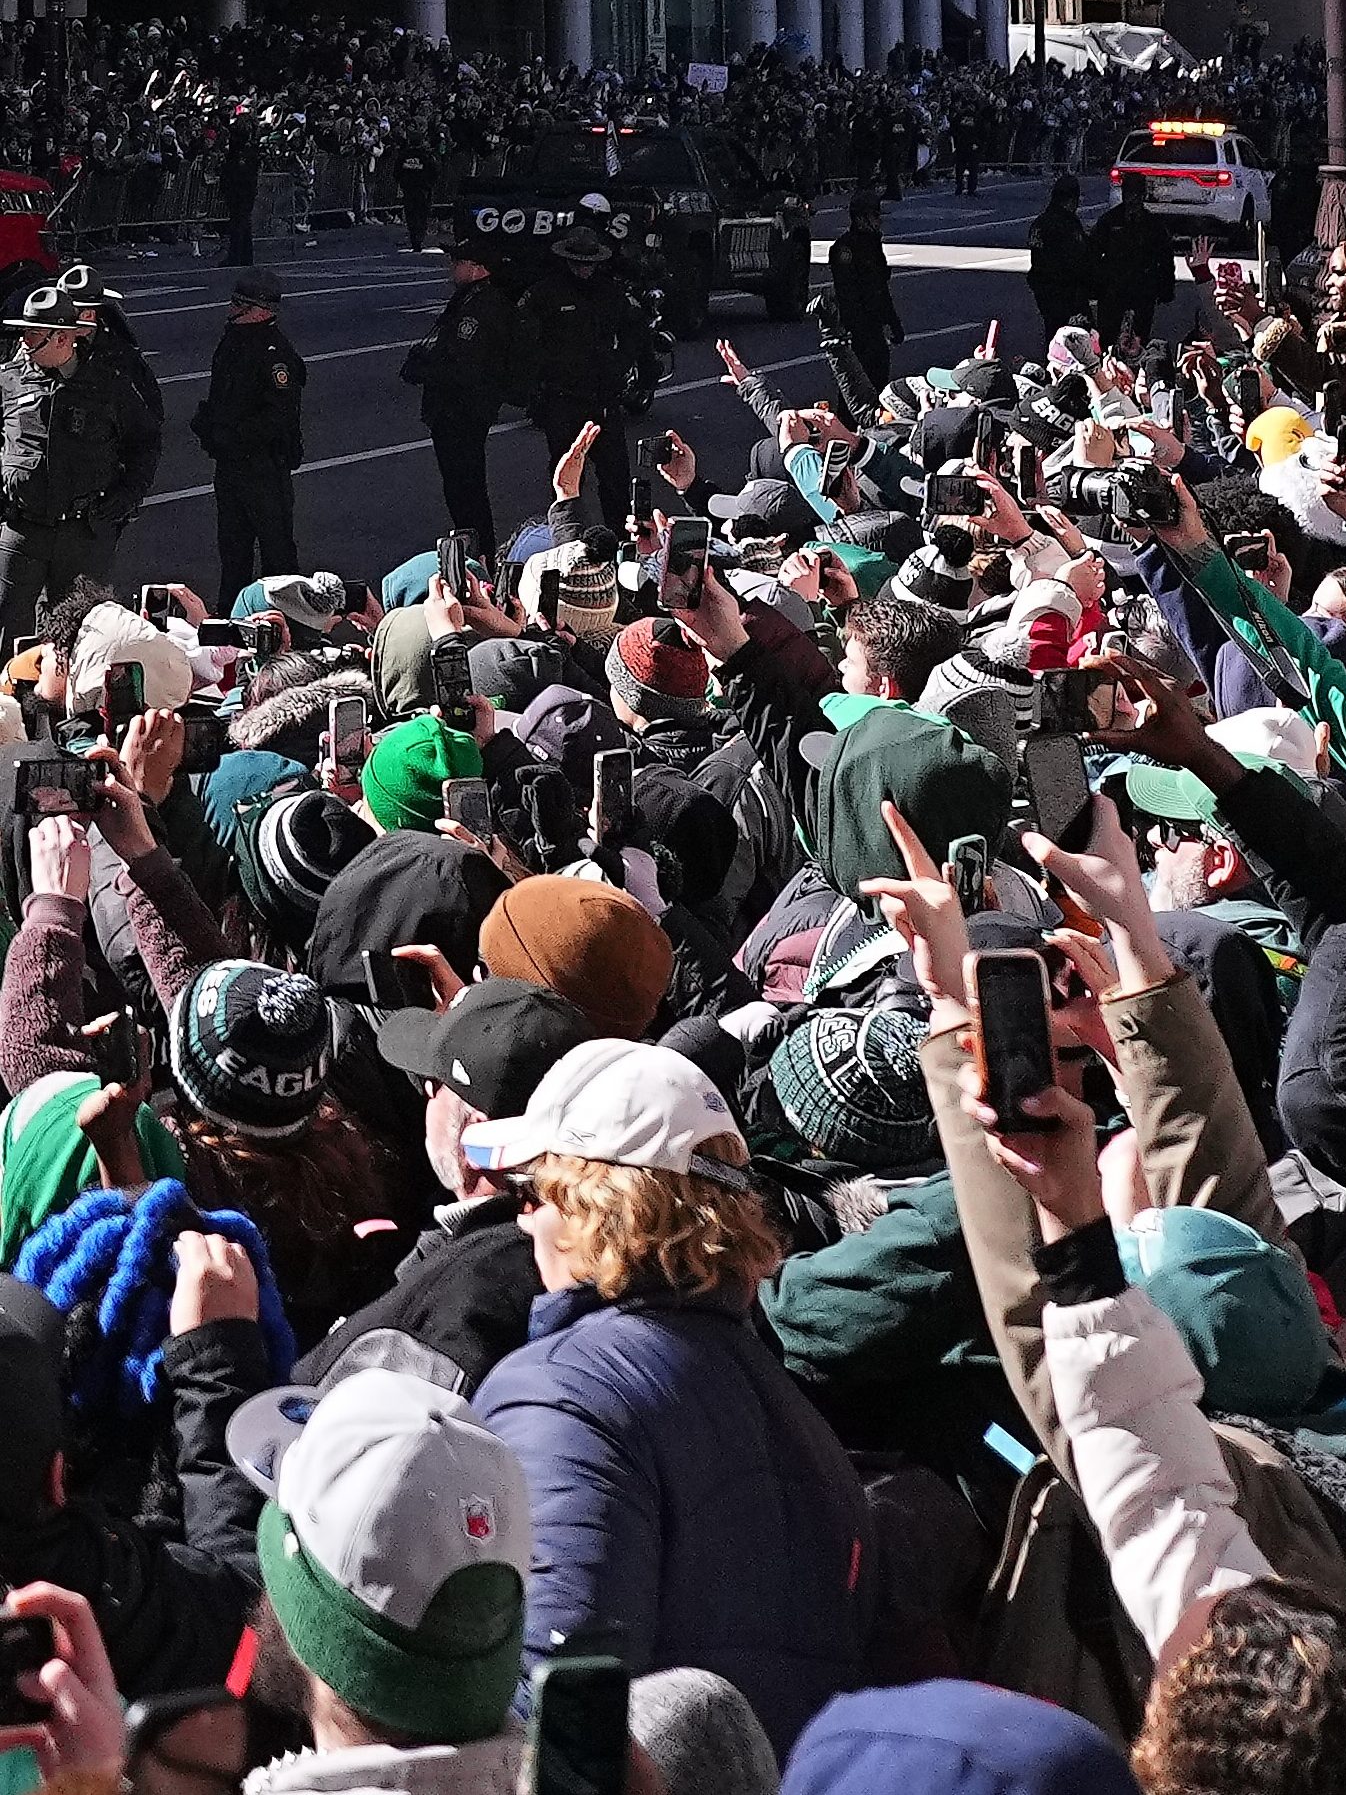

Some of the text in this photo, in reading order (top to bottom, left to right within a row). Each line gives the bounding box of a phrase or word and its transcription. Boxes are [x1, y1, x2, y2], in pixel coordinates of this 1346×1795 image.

[475, 206, 526, 233] GO
[1030, 395, 1076, 434] EAG
[215, 1045, 328, 1098] EAGL
